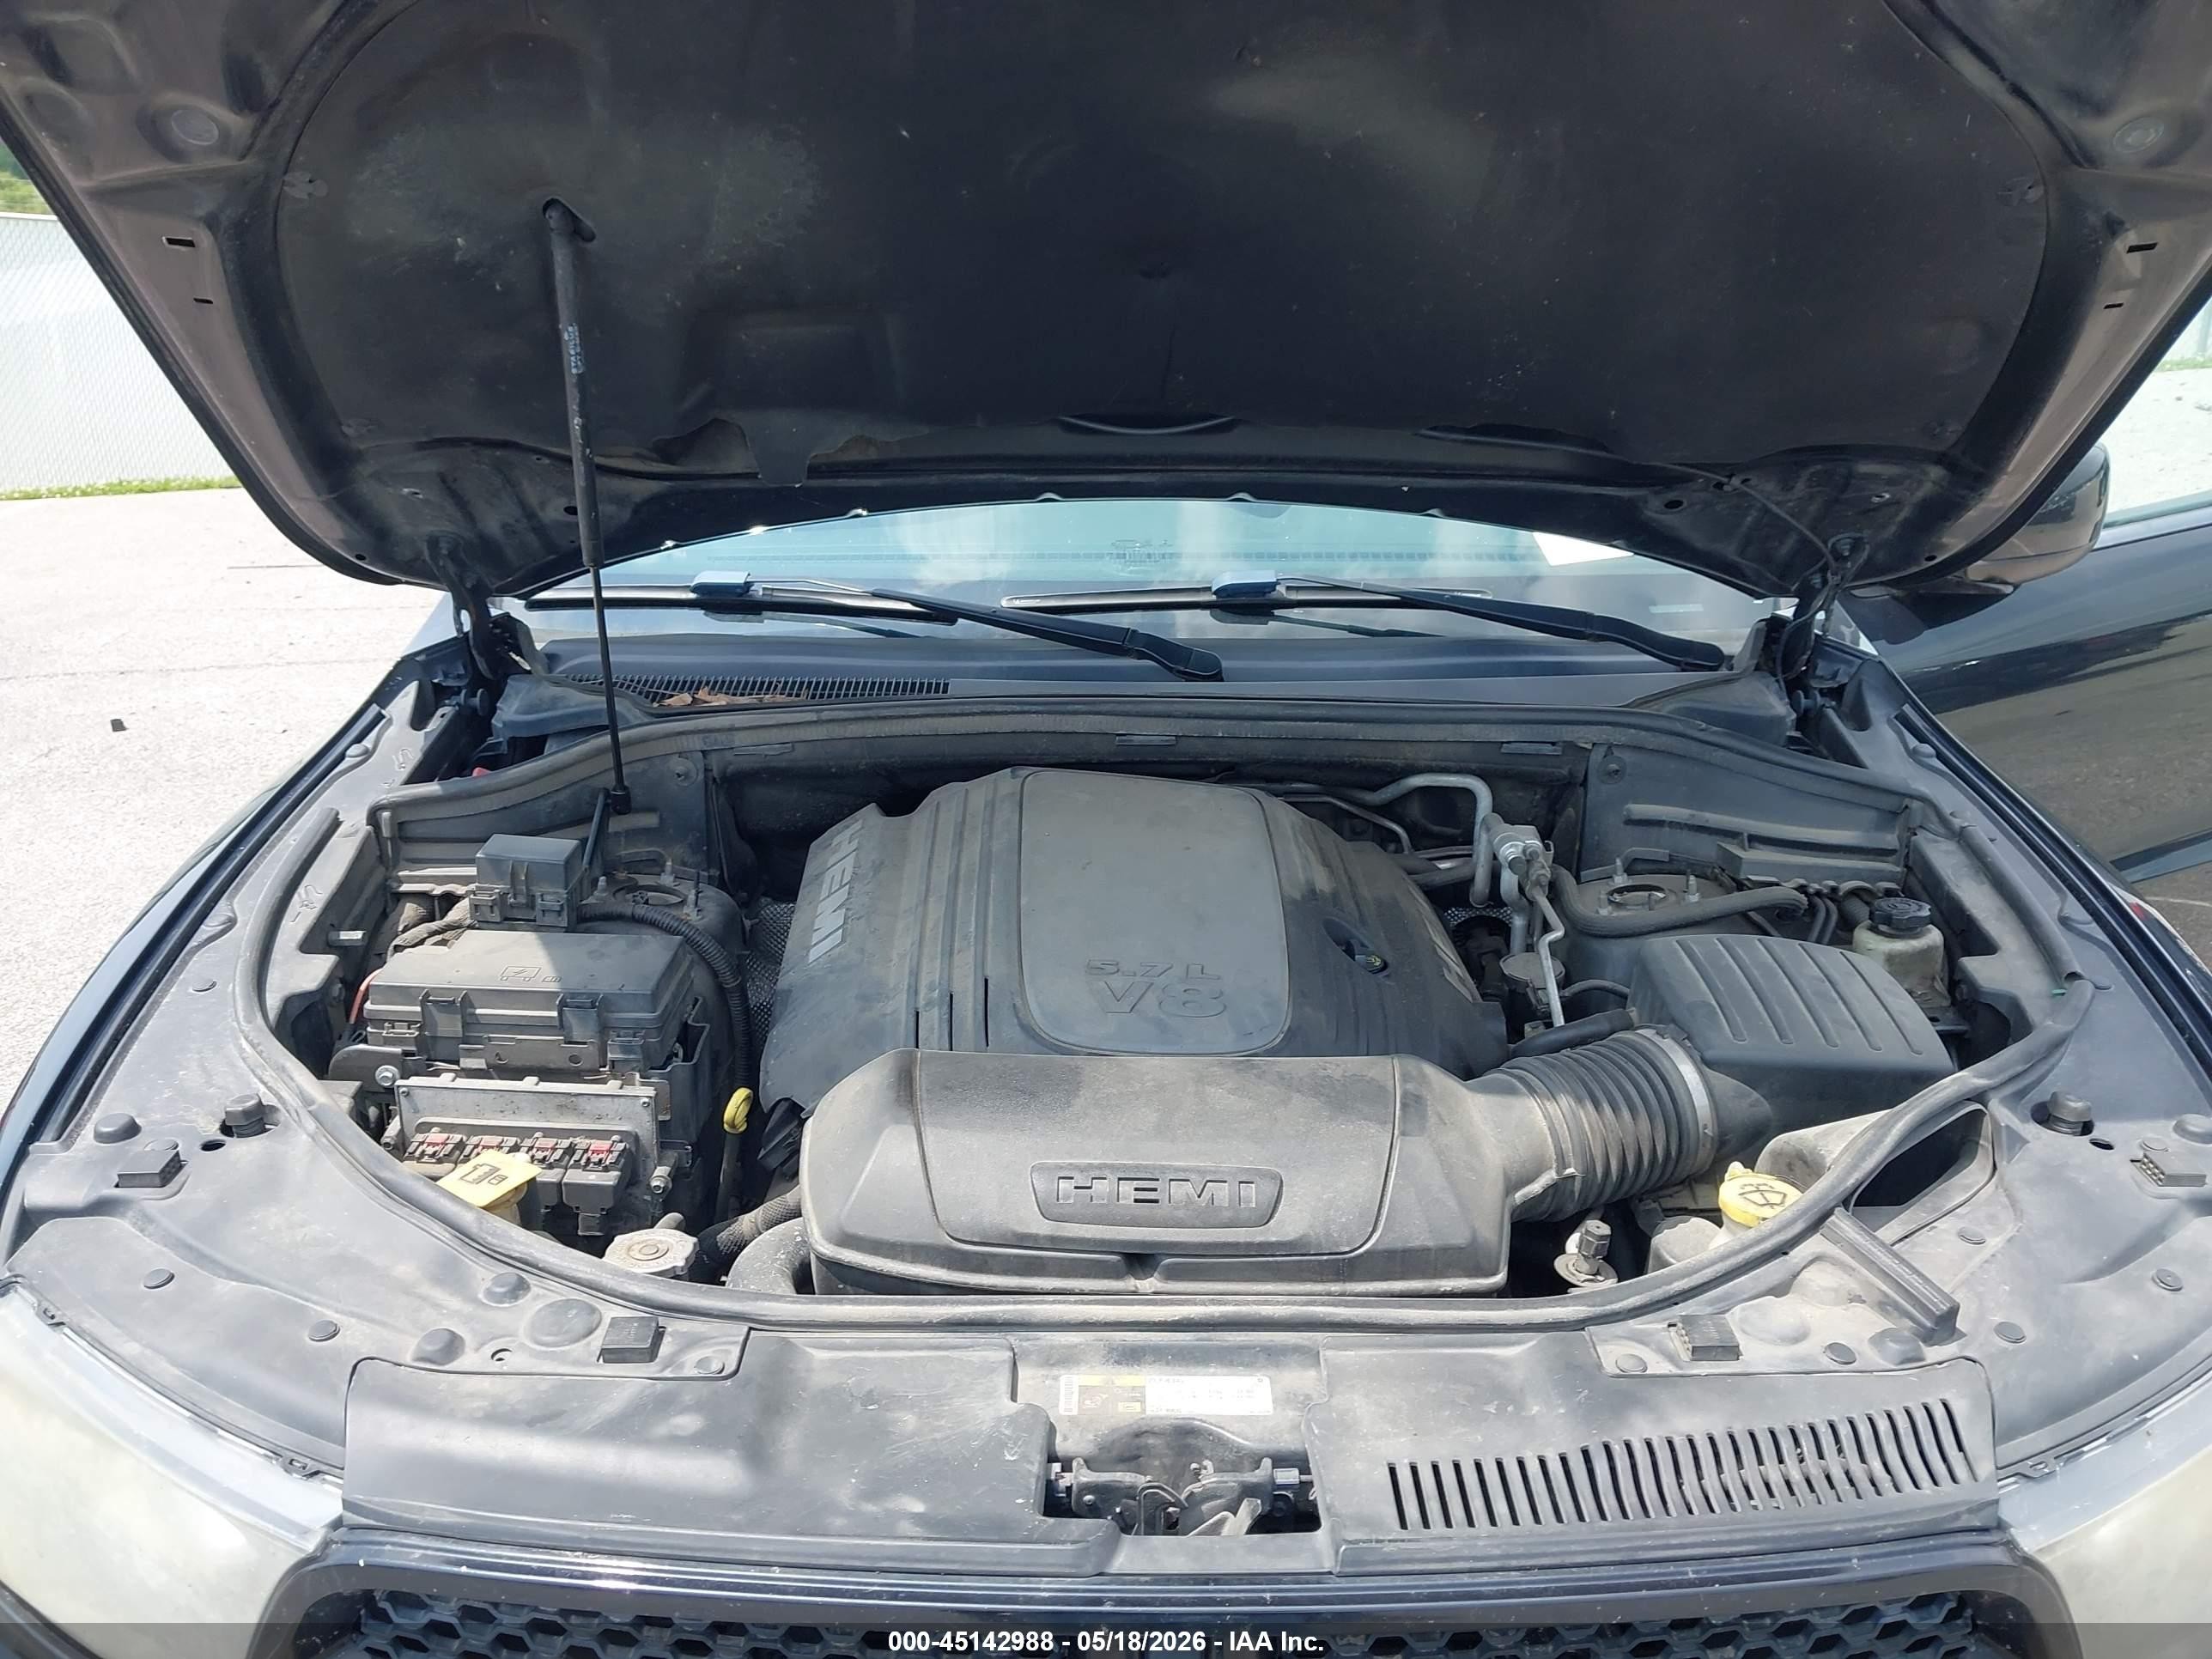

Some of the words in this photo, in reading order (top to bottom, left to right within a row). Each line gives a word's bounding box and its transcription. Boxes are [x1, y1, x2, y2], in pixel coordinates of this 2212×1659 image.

[808, 819, 864, 965] HEMI
[1088, 981, 1227, 1018] V8
[1056, 1175, 1256, 1208] HEMI
